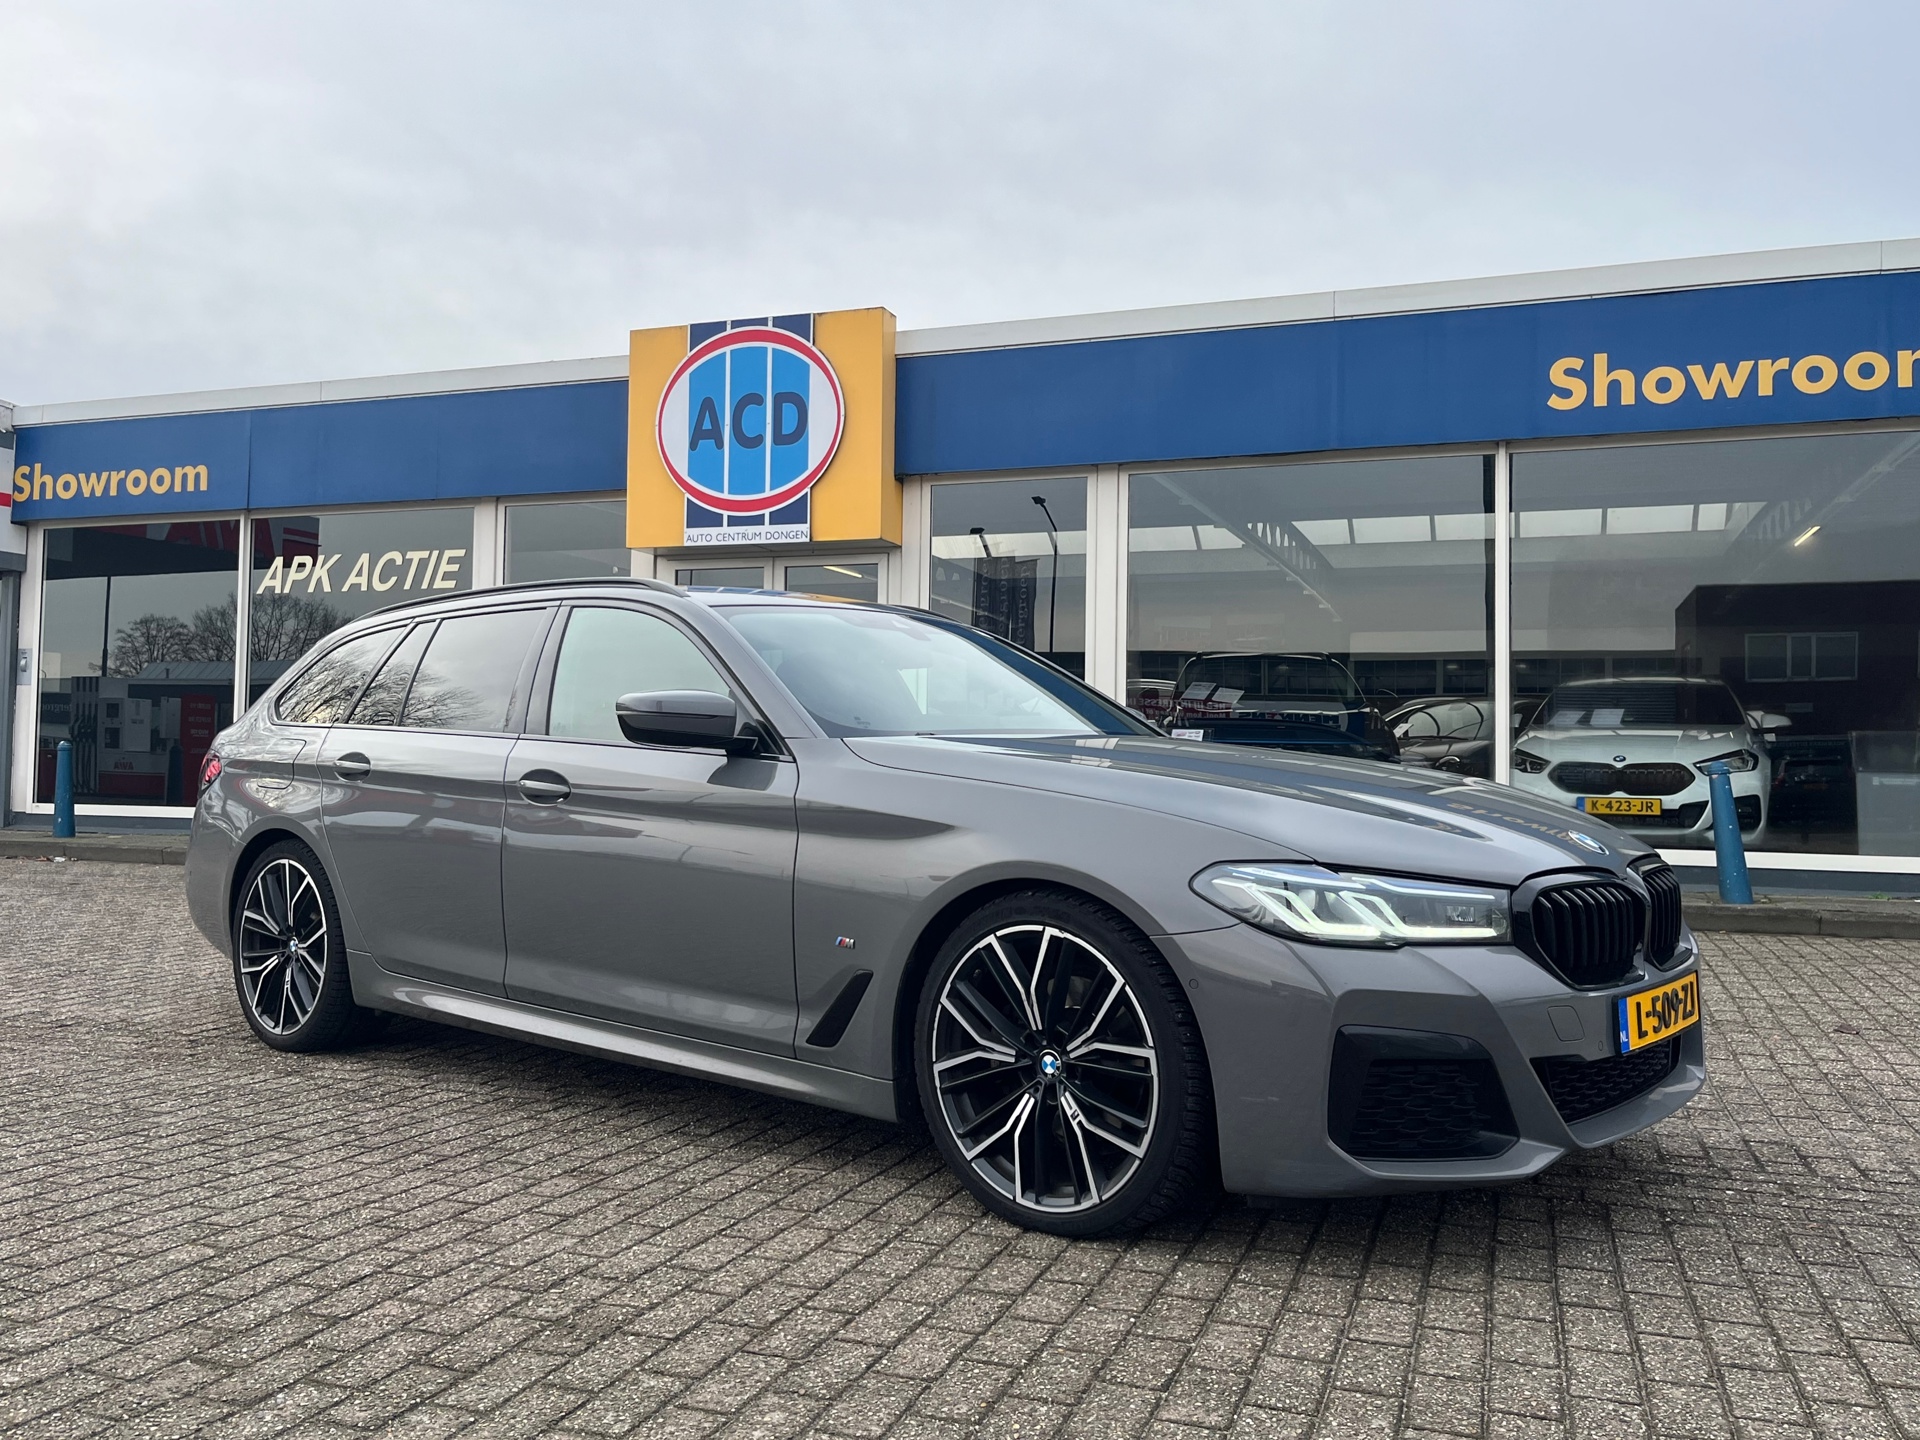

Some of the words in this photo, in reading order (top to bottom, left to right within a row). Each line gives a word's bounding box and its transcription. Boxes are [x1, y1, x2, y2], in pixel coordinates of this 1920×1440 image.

[689, 391, 808, 451] ACD
[13, 463, 208, 502] Showroom
[686, 533, 713, 543] AUTO
[715, 531, 762, 542] CENTRUM
[765, 530, 809, 540] DONGEN
[256, 552, 342, 595] APK
[342, 548, 467, 592] ACTIE
[1591, 799, 1654, 812] K-423-JR
[1635, 981, 1695, 1039] L-509-ZJ
[1620, 1030, 1628, 1043] NL
